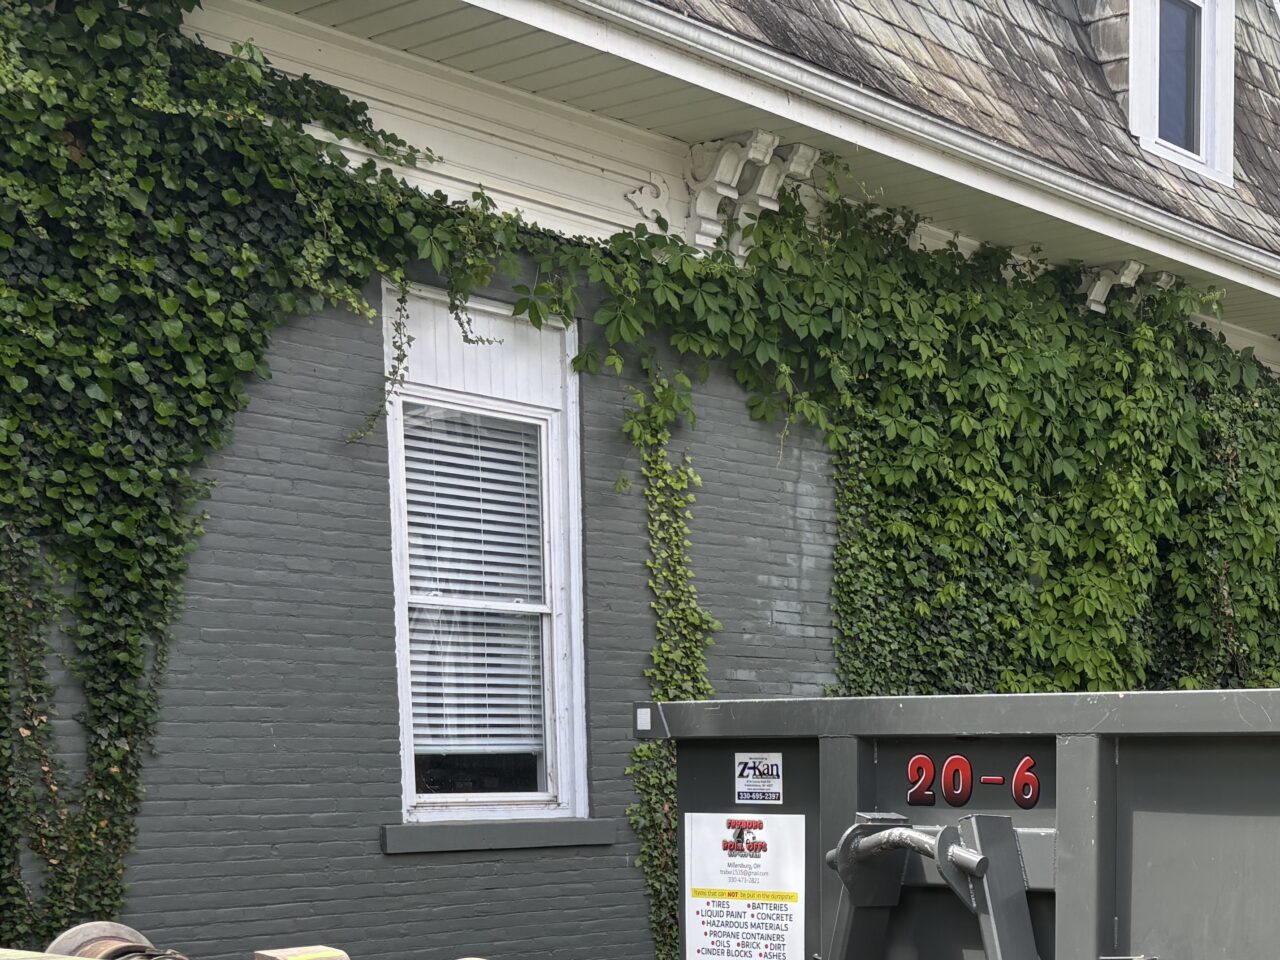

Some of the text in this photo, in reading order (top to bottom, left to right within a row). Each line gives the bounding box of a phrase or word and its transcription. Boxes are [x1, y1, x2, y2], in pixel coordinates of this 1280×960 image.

[737, 760, 780, 779] Z-Kan
[906, 753, 1041, 811] 20-6
[752, 903, 788, 911] BATTERIES
[701, 909, 793, 921] LIQUID PAINT CONCRETE
[706, 920, 788, 931] HAZARDOUS MATERIALS
[709, 930, 784, 942] PROPANE CONTAINERS
[741, 941, 760, 949] BRICK
[769, 943, 786, 951] DIRT
[701, 948, 786, 960] CINDER BLOCKS ASHES
